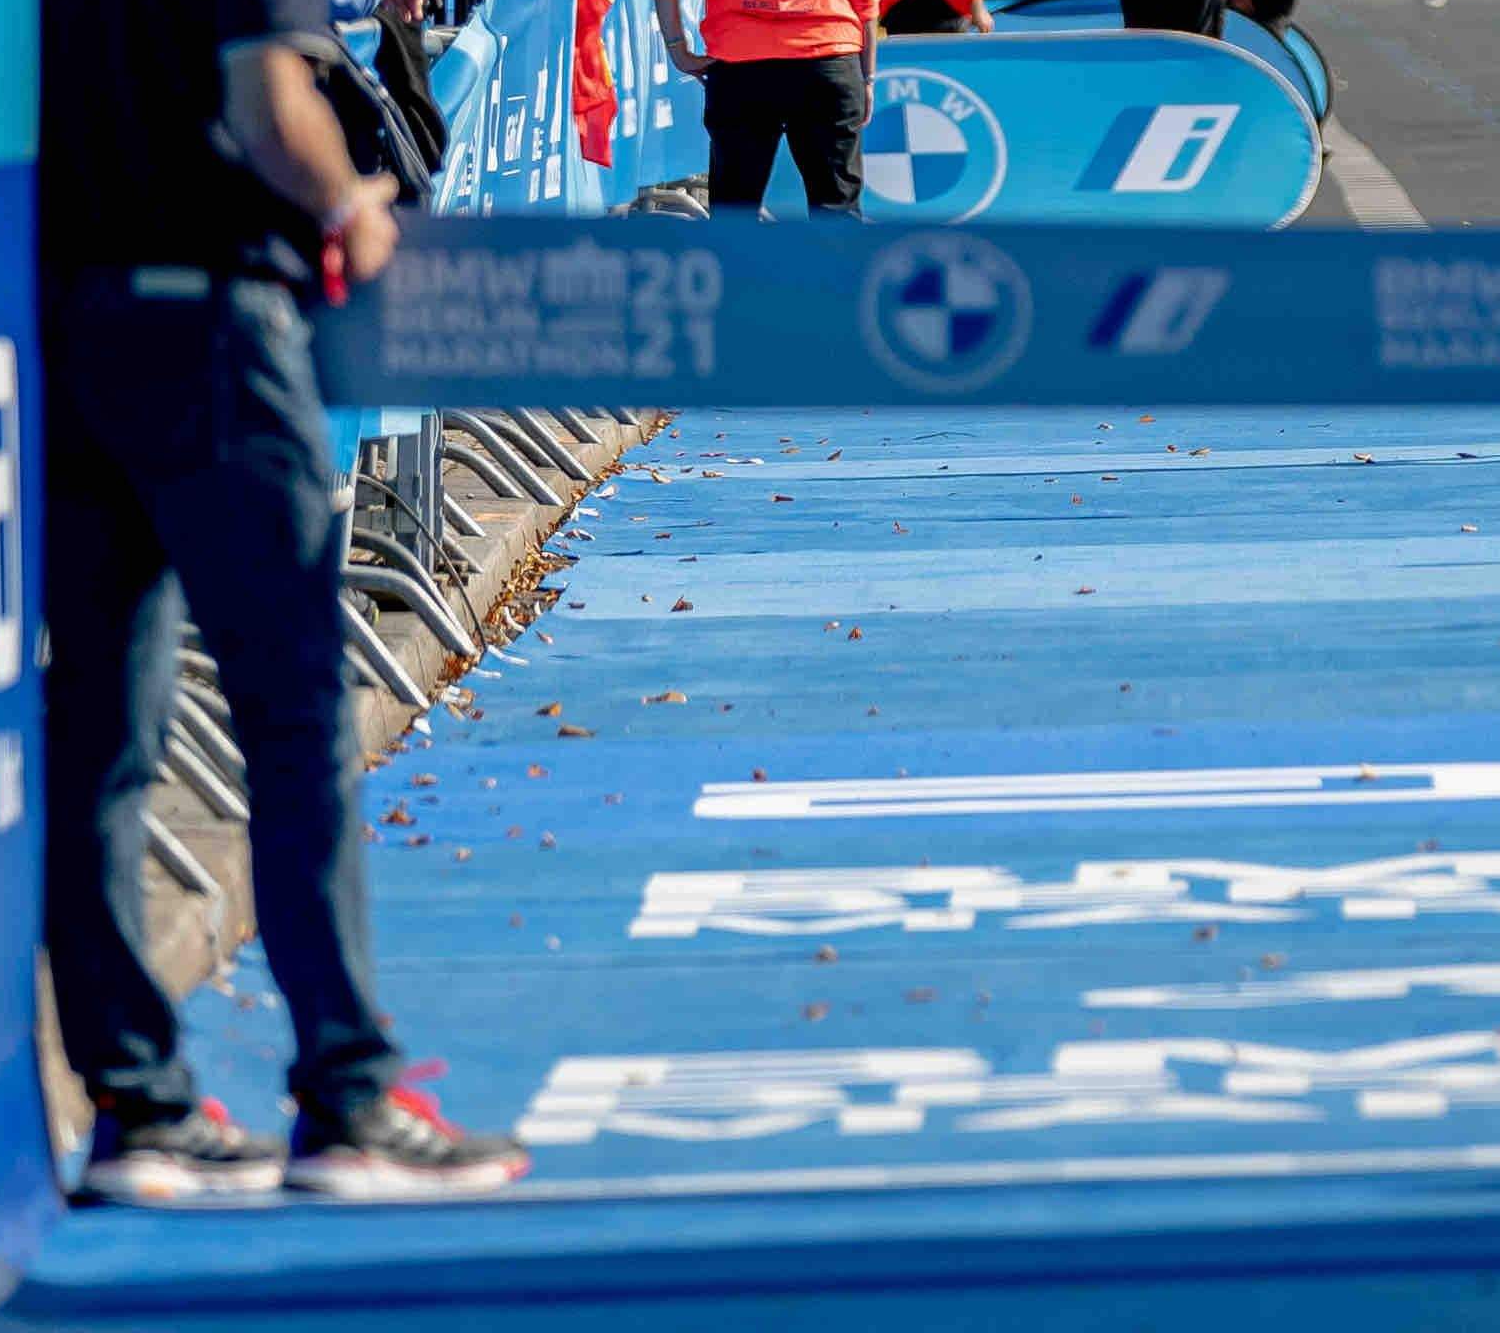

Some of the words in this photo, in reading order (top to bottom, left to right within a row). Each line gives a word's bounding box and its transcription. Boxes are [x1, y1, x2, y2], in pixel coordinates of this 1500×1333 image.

[887, 77, 976, 122] MW
[631, 248, 722, 309] 20
[631, 311, 715, 377] 21
